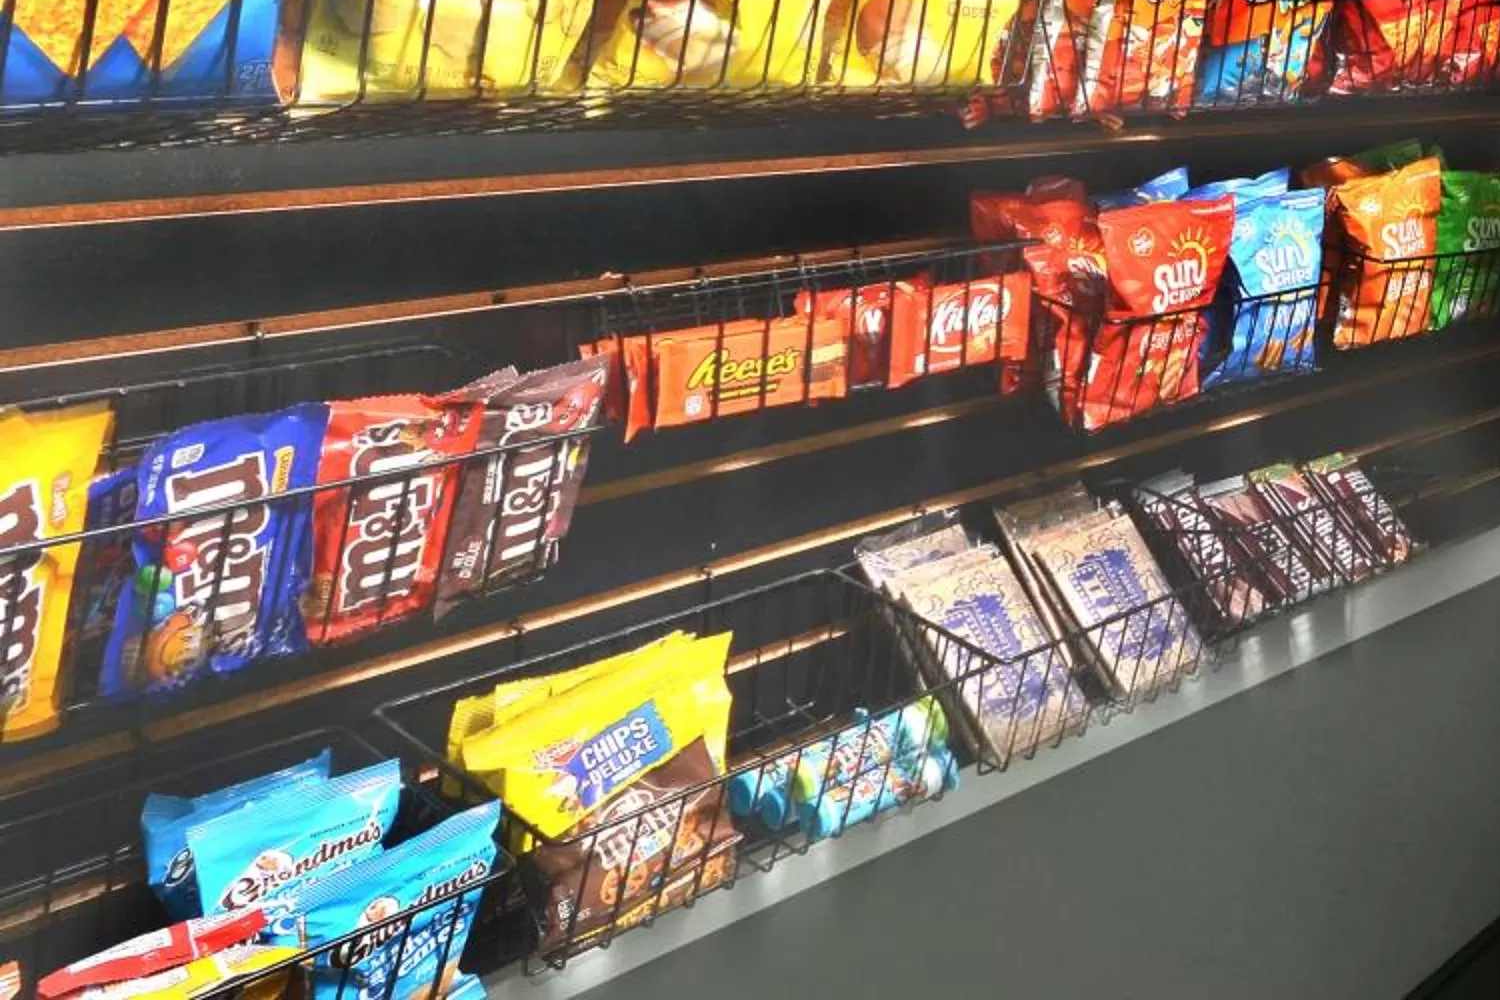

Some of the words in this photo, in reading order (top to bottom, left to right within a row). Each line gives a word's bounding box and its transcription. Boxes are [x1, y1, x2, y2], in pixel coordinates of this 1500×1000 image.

[1382, 216, 1423, 260] Sun
[1151, 258, 1206, 314] Sun
[1255, 245, 1311, 291] Sun
[339, 418, 434, 612] m&m's
[581, 717, 650, 770] CHIPS
[589, 734, 657, 785] DELUXE
[221, 820, 384, 908] Grandma's
